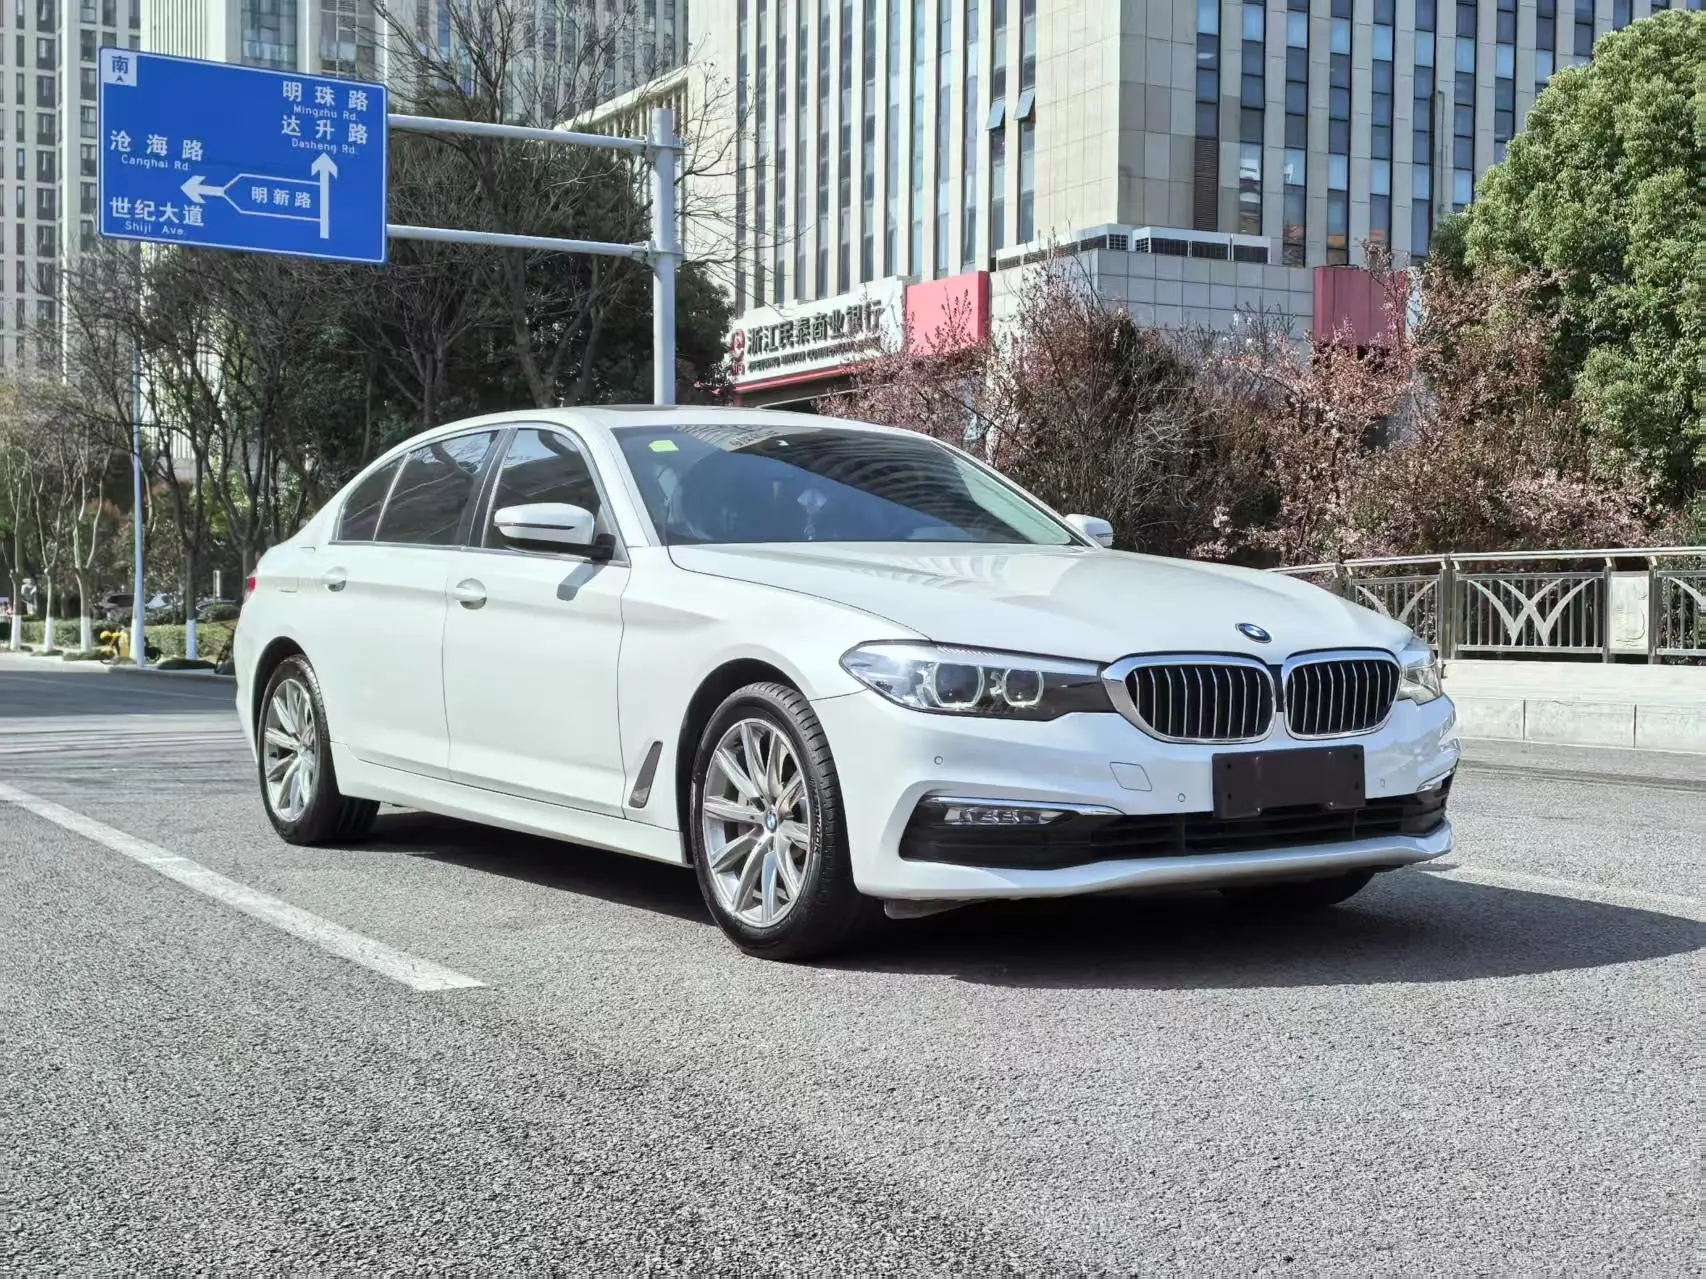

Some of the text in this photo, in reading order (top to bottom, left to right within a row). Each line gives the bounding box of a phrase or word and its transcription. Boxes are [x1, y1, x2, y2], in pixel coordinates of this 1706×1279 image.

[112, 55, 128, 74] 南
[282, 81, 368, 111] 明珠路
[293, 104, 337, 118] Mingzhu
[281, 115, 368, 144] 达升路
[110, 129, 203, 161] 沧海路
[291, 138, 337, 153] Dasheng
[121, 154, 168, 169] Canghai
[251, 186, 312, 209] 明新路
[109, 196, 204, 227] 世纪大道
[124, 221, 152, 234] Shiji
